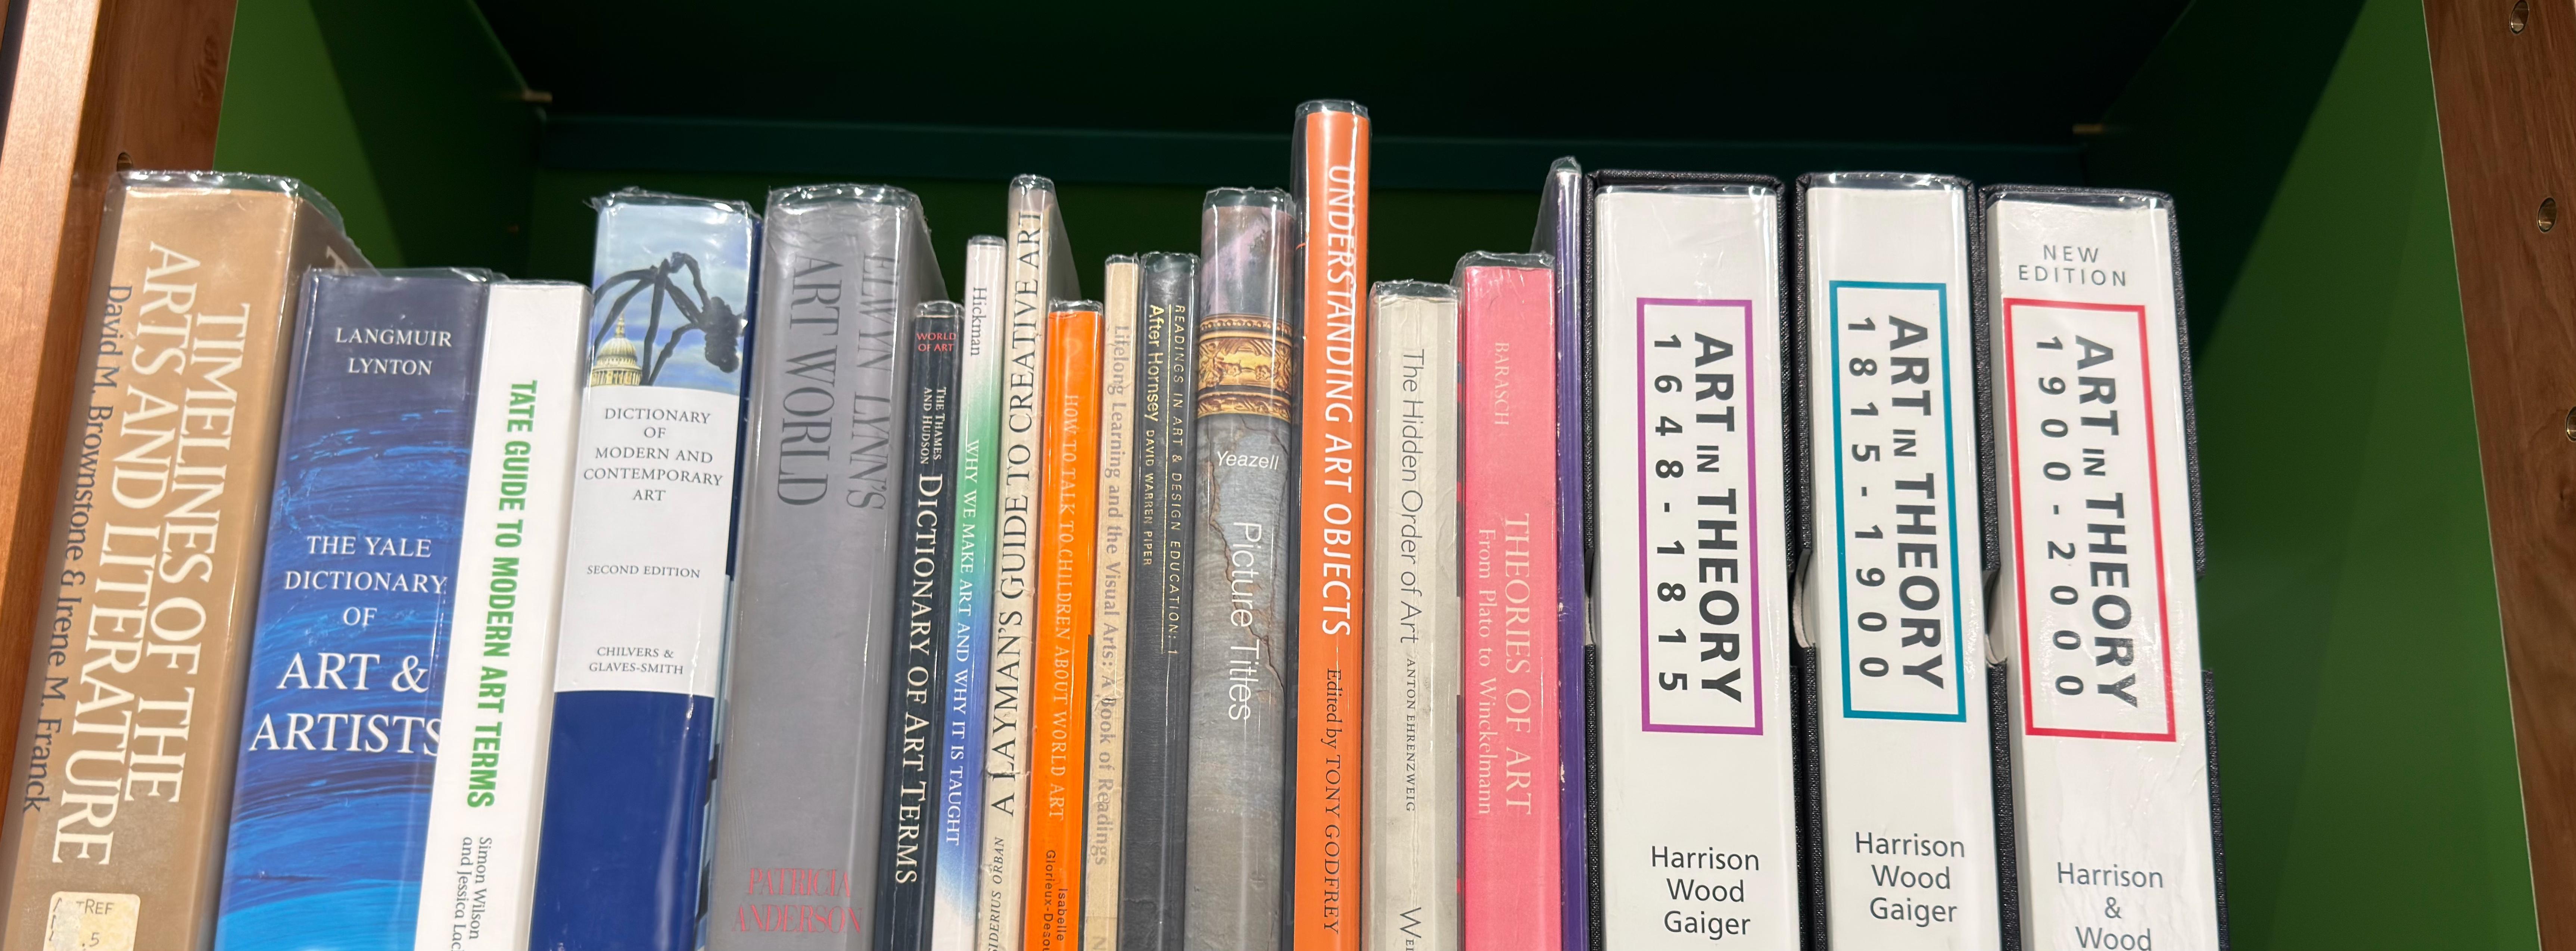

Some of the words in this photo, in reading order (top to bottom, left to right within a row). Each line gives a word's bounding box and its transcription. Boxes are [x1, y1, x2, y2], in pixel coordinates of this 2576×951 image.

[1018, 211, 1041, 270] ART
[2043, 245, 2099, 263] NEW
[790, 254, 843, 336] ART
[1325, 165, 1355, 423] UNDERSTANDING
[2019, 265, 2126, 287] EDITION
[97, 285, 132, 359] David
[132, 241, 201, 376] ARTS
[857, 252, 898, 372] ELWYN
[971, 287, 987, 356] Hickman
[1149, 305, 1164, 347] After
[336, 327, 451, 347] LANGMUIR
[918, 343, 931, 351] OF
[1008, 279, 1038, 433] CREATIVE
[1174, 305, 1186, 383] READINGS
[91, 366, 120, 394] M.
[349, 358, 432, 375] LYNTON
[1108, 326, 1130, 395] Lifelong
[1403, 349, 1424, 392] The
[1695, 332, 1735, 432] ART
[1889, 315, 1931, 416] ART
[507, 380, 538, 432] TATE
[923, 388, 932, 411] AND
[936, 387, 947, 410] THE
[1144, 353, 1164, 422] Hornsey
[1173, 393, 1183, 408] IN
[1495, 342, 1510, 425] BARASCH
[2075, 335, 2119, 436] ART
[605, 408, 711, 423] DICTIONARY
[644, 427, 666, 438] OF
[778, 344, 838, 506] WORLD
[933, 413, 945, 460] THAMES
[1065, 395, 1078, 434] HOW
[1173, 416, 1183, 446] ART
[112, 386, 179, 509] AND
[159, 303, 250, 584] TIMELINES
[596, 447, 669, 459] MODERN
[676, 451, 713, 463] AND
[921, 416, 932, 464] HUDSON
[965, 439, 979, 483] WHY
[1063, 441, 1077, 462] TO
[1105, 403, 1127, 478] Learning
[1145, 430, 1155, 466] DAVID
[1172, 454, 1182, 463] &
[1217, 451, 1279, 470] Yeazell
[1402, 400, 1424, 481] Hidden
[1697, 445, 1719, 472] IN
[1893, 429, 1916, 457] IN
[2082, 448, 2106, 476] IN
[65, 405, 113, 561] Brownstone
[499, 441, 531, 511] GUIDE
[584, 468, 723, 486] CONTEMPORARY
[1007, 445, 1031, 486] TO
[1325, 434, 1352, 493] ART
[633, 490, 666, 501] ART
[963, 489, 976, 518] WE
[1059, 469, 1076, 514] TALK
[1108, 485, 1123, 517] and
[1144, 473, 1153, 523] WARREN
[1171, 473, 1182, 530] DESIGN
[307, 536, 355, 555] THE
[368, 538, 431, 558] YALE
[495, 519, 523, 547] TO
[961, 523, 975, 573] MAKE
[1001, 495, 1028, 599] GUIDE
[1059, 521, 1074, 542] TO
[1106, 525, 1122, 554] the
[1144, 531, 1152, 565] PIPER
[1401, 490, 1423, 564] Order
[587, 565, 639, 575] SECOND
[644, 566, 700, 578] EDITION
[910, 474, 943, 655] DICTIONARY
[1231, 522, 1262, 627] Picture
[1323, 503, 1352, 635] OBJECTS
[1479, 529, 1496, 578] From
[60, 572, 85, 586] &
[285, 571, 448, 594] DICTIONARY
[959, 579, 972, 616] ART
[1056, 549, 1073, 639] CHILDREN
[1104, 562, 1121, 615] Visual
[1401, 572, 1422, 597] of
[1505, 513, 1530, 673] THEORIES
[1697, 488, 1741, 703] THEORY
[1895, 473, 1944, 689] THEORY
[2086, 492, 2138, 708] THEORY
[343, 607, 377, 626] OF
[483, 557, 520, 657] MODERN
[1401, 601, 1422, 643] Art
[1479, 590, 1497, 638] Plato
[47, 598, 82, 667] Irene
[147, 597, 206, 675] OF
[597, 647, 658, 657] CHILVERS
[664, 650, 674, 658] &
[956, 623, 970, 662] AND
[1102, 623, 1118, 666] Arts:
[277, 653, 379, 690] ART
[392, 656, 429, 692] &
[589, 663, 683, 675] GLAVES-SMITH
[1053, 647, 1069, 705] ABOUT
[1228, 639, 1259, 720] Titles
[1479, 648, 1492, 667] to
[38, 678, 69, 707] M.
[52, 522, 160, 865] LITERATURE
[477, 666, 508, 713] ART
[907, 666, 929, 704] OF
[953, 669, 968, 714] WHY
[992, 611, 1022, 781] LAYMAN'S
[1102, 675, 1116, 688] A
[1326, 668, 1342, 723] Edited
[1407, 658, 1415, 709] ANTON
[952, 722, 965, 739] IT
[1100, 698, 1116, 744] Book
[1505, 688, 1531, 733] OF
[124, 687, 195, 803] THE
[249, 713, 442, 756] ARTISTS
[903, 712, 929, 772] ART
[951, 746, 964, 760] IS
[1051, 711, 1067, 776] WORLD
[1321, 728, 1342, 749] by
[1479, 677, 1498, 814] Winckelmann
[23, 719, 61, 813] Franck
[467, 726, 506, 808] TERMS
[1099, 752, 1115, 770] of
[1407, 714, 1415, 811] EHRENZWEIG
[1506, 747, 1532, 815] ART
[946, 766, 963, 846] TAUGHT
[991, 793, 1015, 817] A
[1049, 783, 1065, 821] ART
[1326, 755, 1340, 818] TONY
[895, 782, 927, 884] TERMS
[1090, 779, 1114, 866] Readings
[1856, 832, 1965, 857] Harrison
[461, 837, 473, 866] and
[476, 837, 492, 883] Simon
[993, 836, 1004, 884] ORBAN
[1652, 845, 1759, 870] Harrison
[455, 871, 472, 919] Jessica
[749, 868, 851, 898] PATRICIA
[1324, 825, 1340, 935] GODFREY
[1666, 878, 1744, 902] Wood
[1871, 864, 1950, 889] Wood
[2058, 862, 2163, 888] Harrison
[469, 889, 486, 939] Wilson
[731, 905, 862, 934] ANDERSON
[1057, 889, 1068, 941] Isabelle
[1664, 910, 1750, 940] Gaiger
[1870, 897, 1957, 927] Gaiger
[2105, 897, 2122, 919] &
[452, 925, 466, 951] Lac
[2075, 926, 2152, 951] Wood
